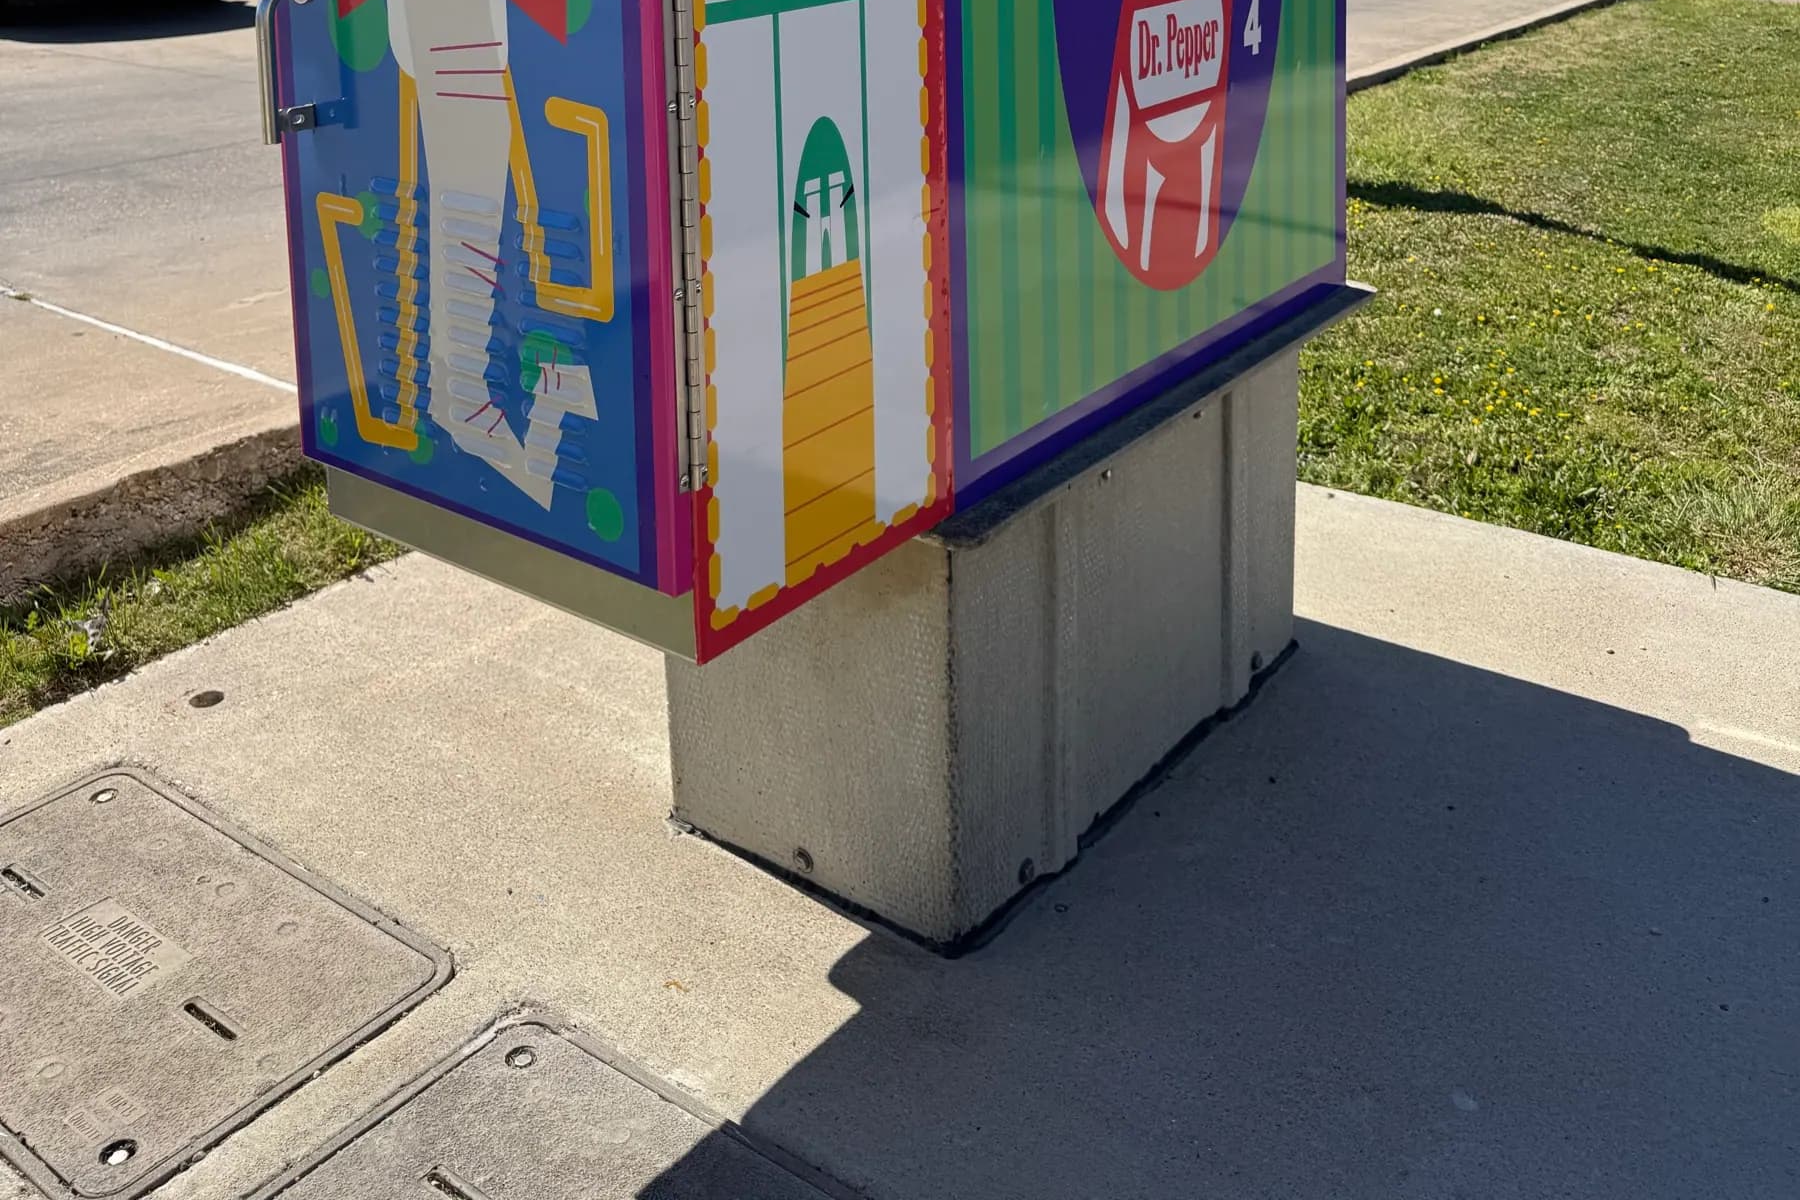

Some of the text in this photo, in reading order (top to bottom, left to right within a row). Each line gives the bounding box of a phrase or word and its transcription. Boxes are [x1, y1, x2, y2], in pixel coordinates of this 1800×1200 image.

[1137, 13, 1219, 81] Dr. Pepper
[43, 924, 140, 997] TRAFFIC SIGNAL
[68, 915, 160, 980] HIGH VOLTAGE
